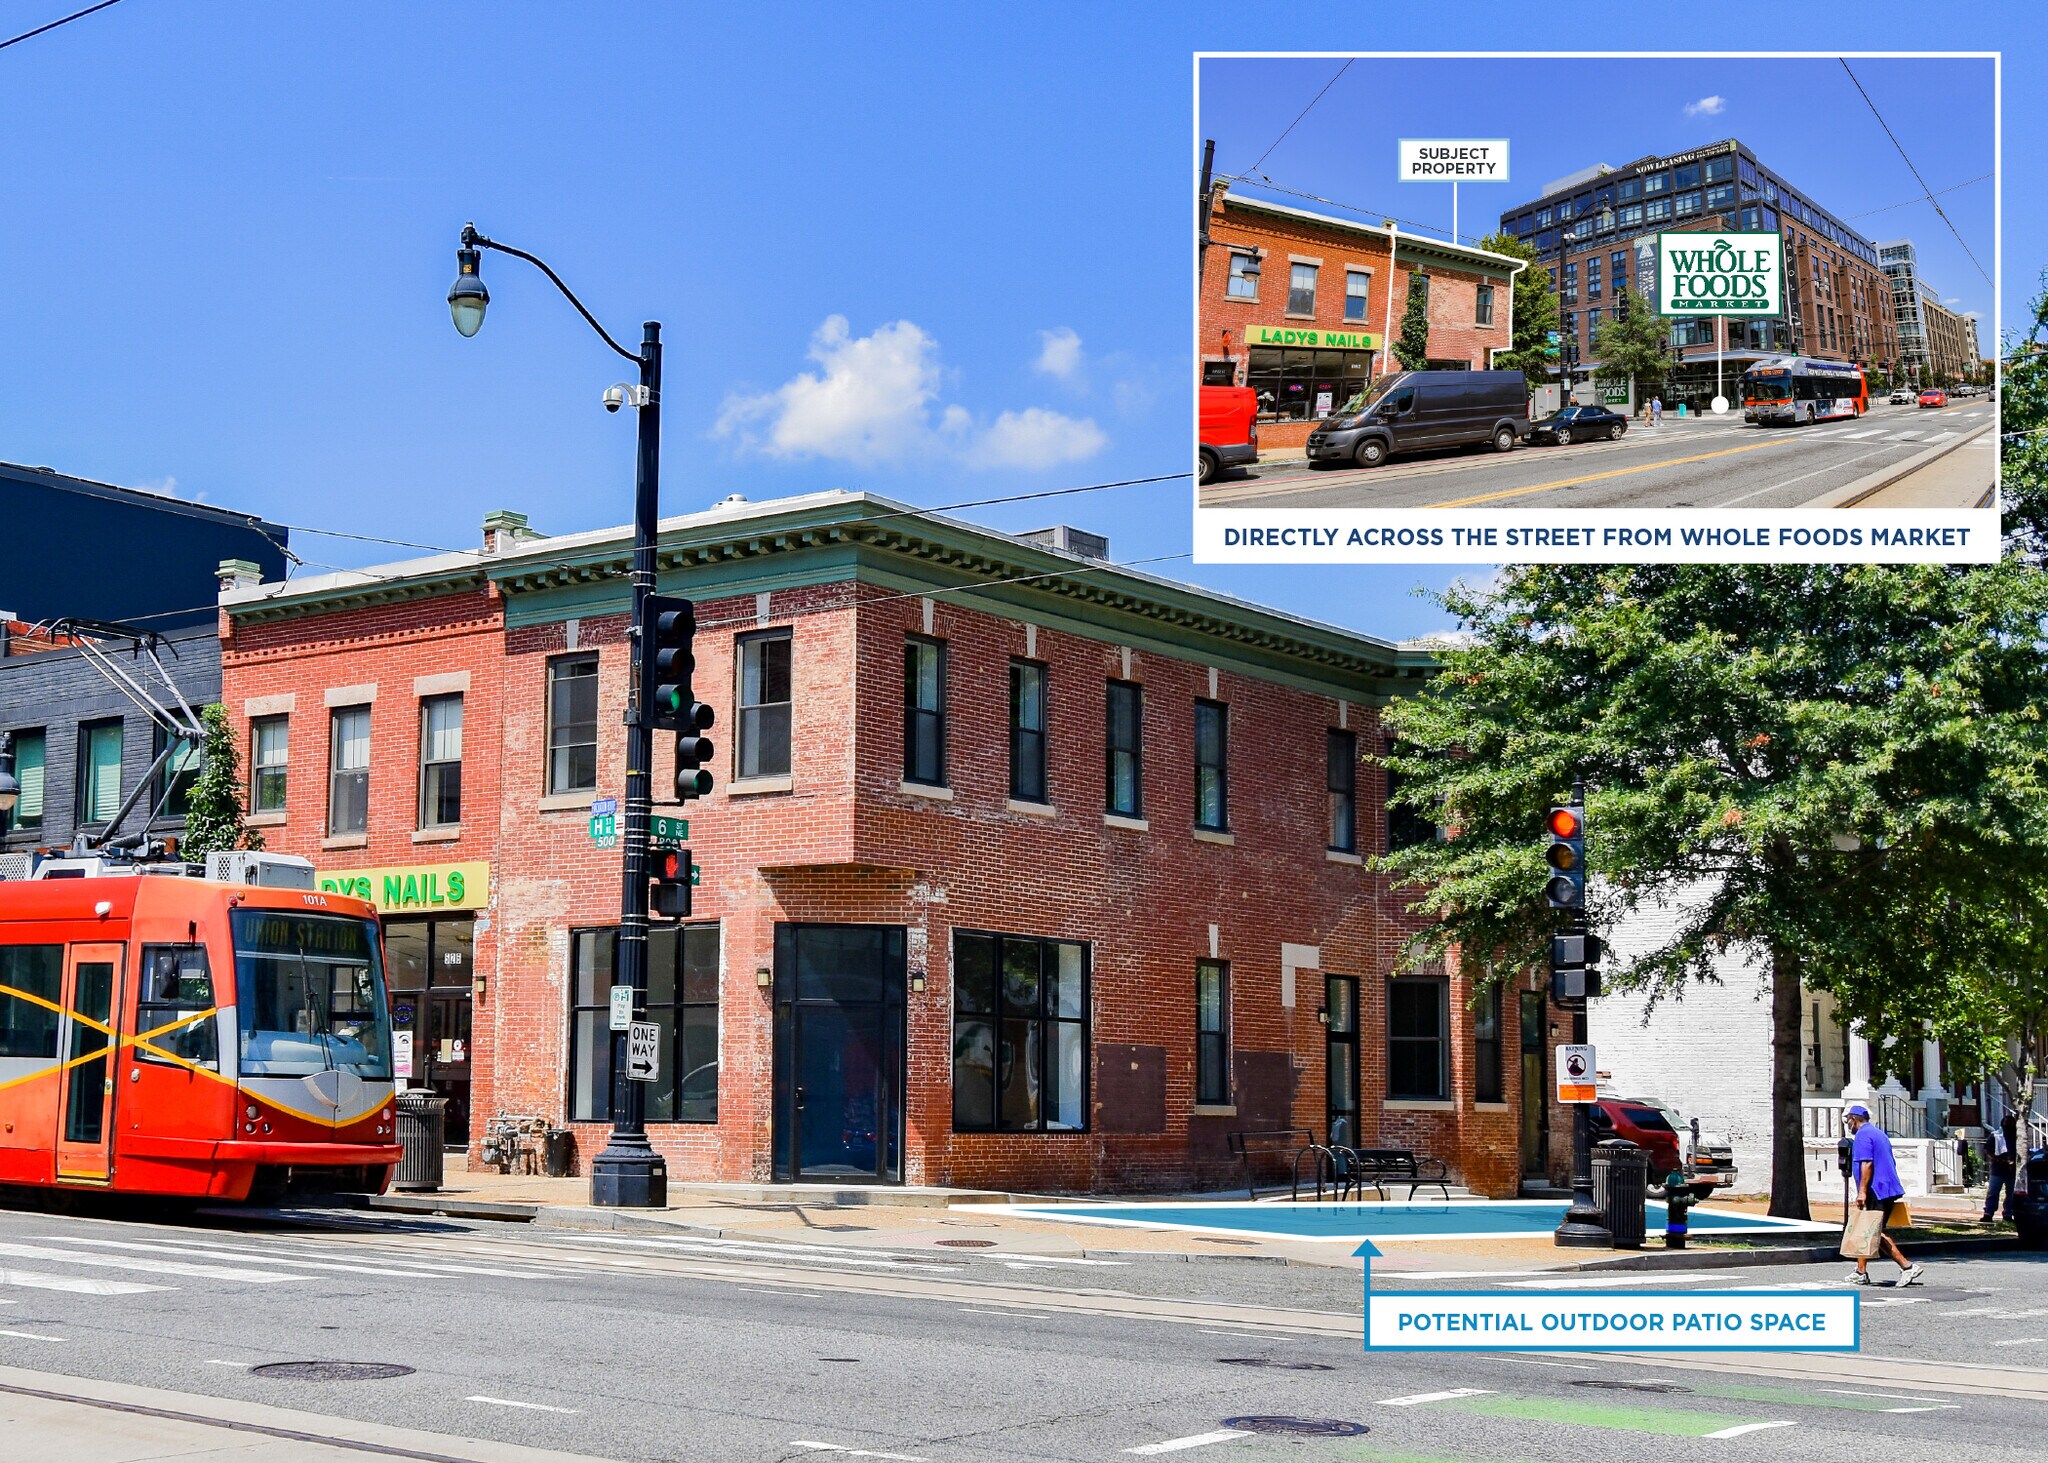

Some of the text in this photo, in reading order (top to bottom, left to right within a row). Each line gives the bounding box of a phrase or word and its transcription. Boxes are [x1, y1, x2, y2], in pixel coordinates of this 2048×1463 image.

[1635, 162, 1655, 175] NOW
[1655, 151, 1695, 170] LEASING
[1260, 328, 1372, 348] LADYS NAILS
[594, 819, 603, 835] H
[657, 819, 684, 835] 6 ST
[675, 829, 684, 837] NE
[597, 835, 615, 847] 500
[383, 871, 465, 907] NAILS
[302, 894, 327, 907] 101A
[245, 919, 359, 951] UNION STATION
[633, 1026, 656, 1042] ONE
[632, 1042, 656, 1058] WAY
